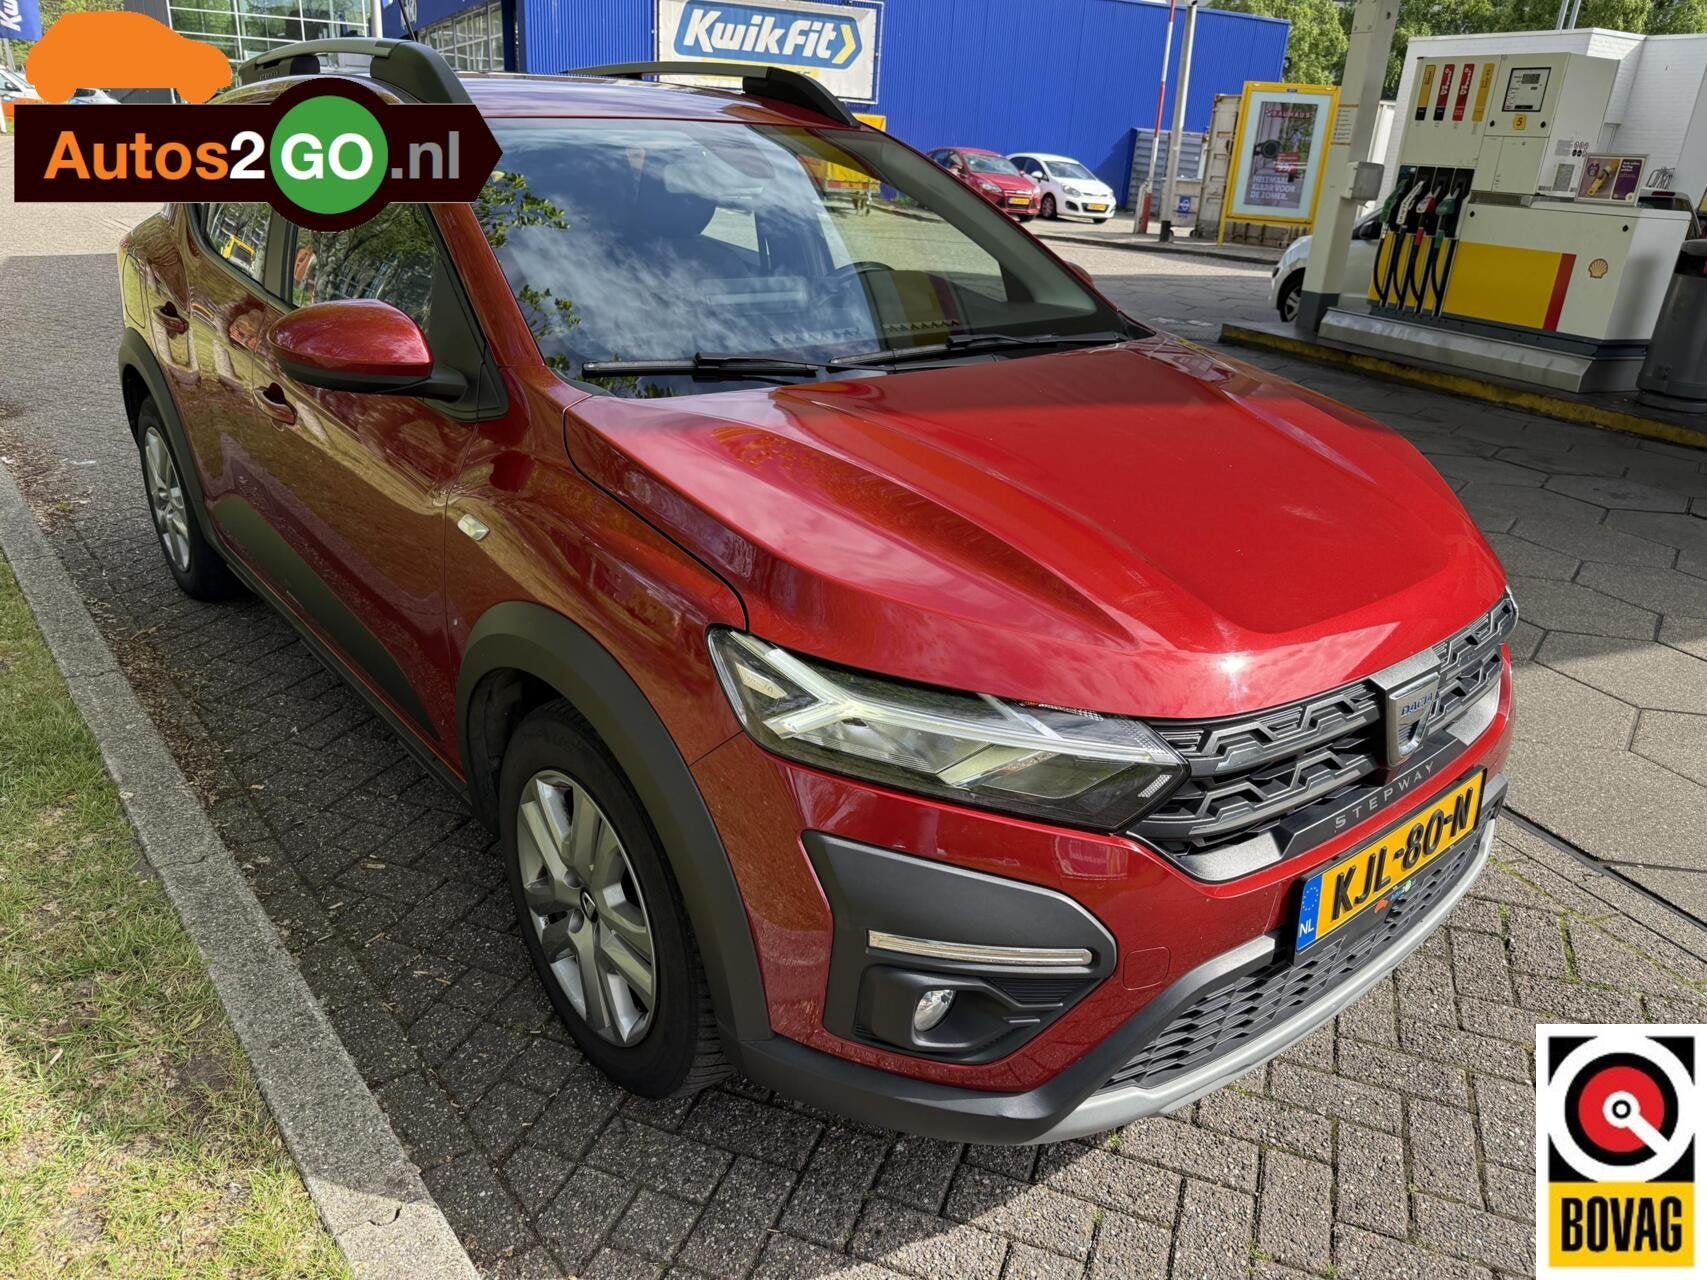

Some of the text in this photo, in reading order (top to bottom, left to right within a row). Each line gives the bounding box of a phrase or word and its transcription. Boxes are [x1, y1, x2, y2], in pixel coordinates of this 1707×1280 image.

[1335, 761, 1434, 829] STEPWAY
[1331, 786, 1474, 920] KJL-80-N
[1299, 922, 1314, 938] NL
